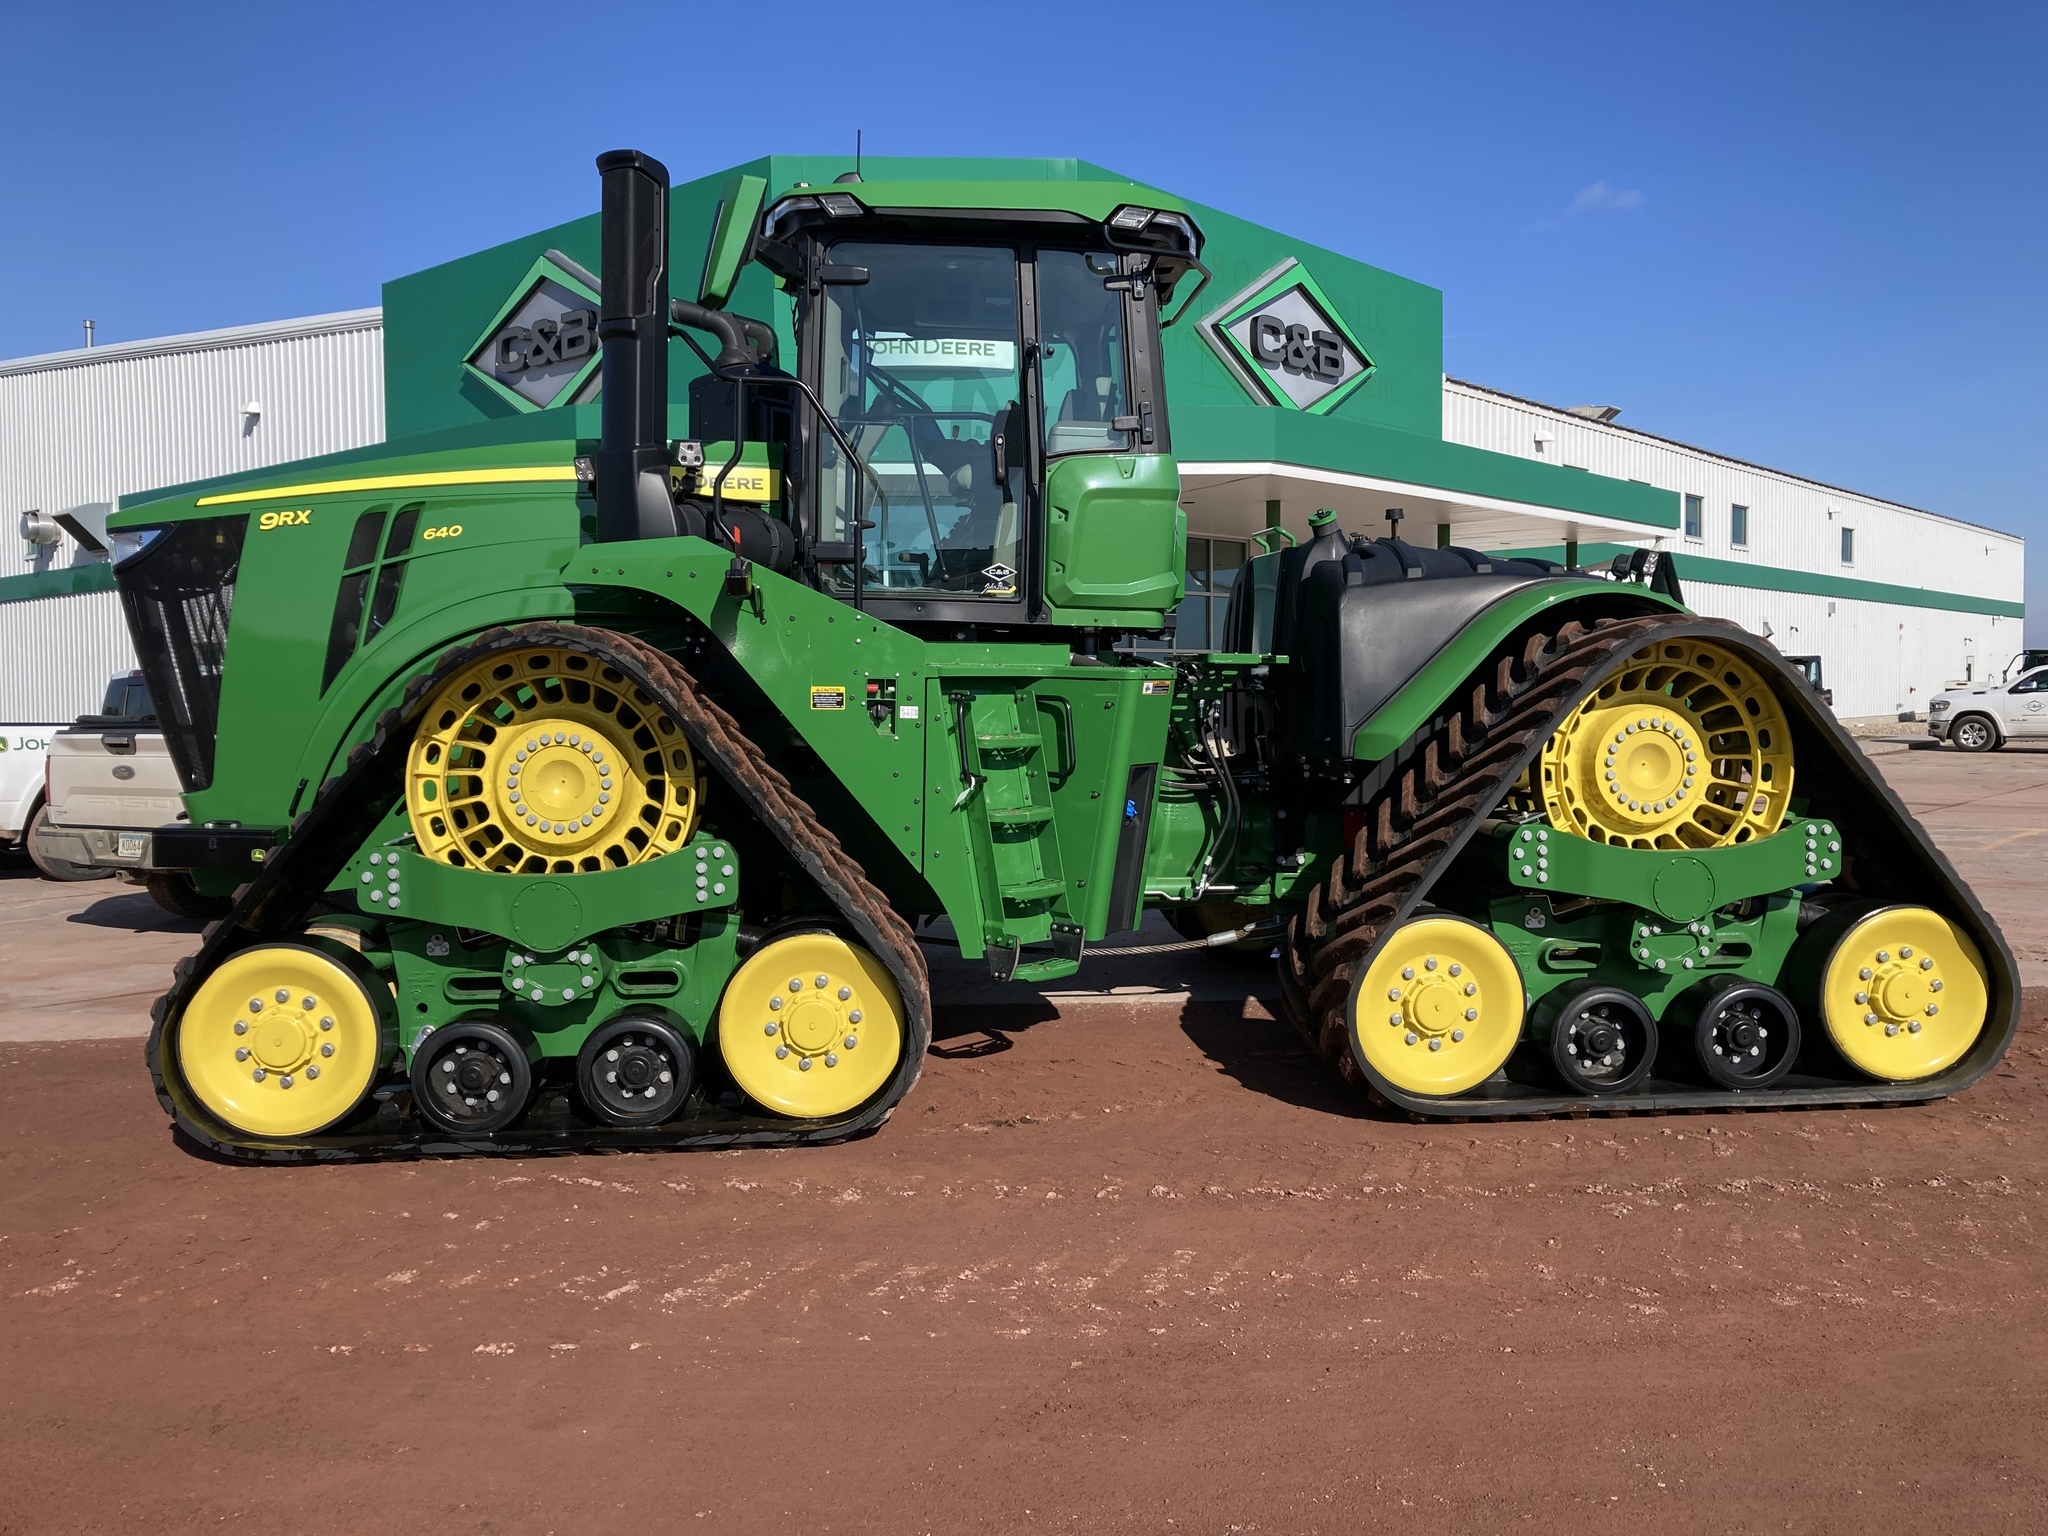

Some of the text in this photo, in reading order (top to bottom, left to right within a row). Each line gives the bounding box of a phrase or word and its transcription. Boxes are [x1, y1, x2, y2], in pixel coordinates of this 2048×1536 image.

[494, 308, 598, 373] C&B
[923, 339, 996, 357] DEERE
[1249, 314, 1345, 378] C&B
[259, 509, 313, 530] 9RX
[423, 525, 463, 540] 640
[13, 736, 51, 750] JOH
